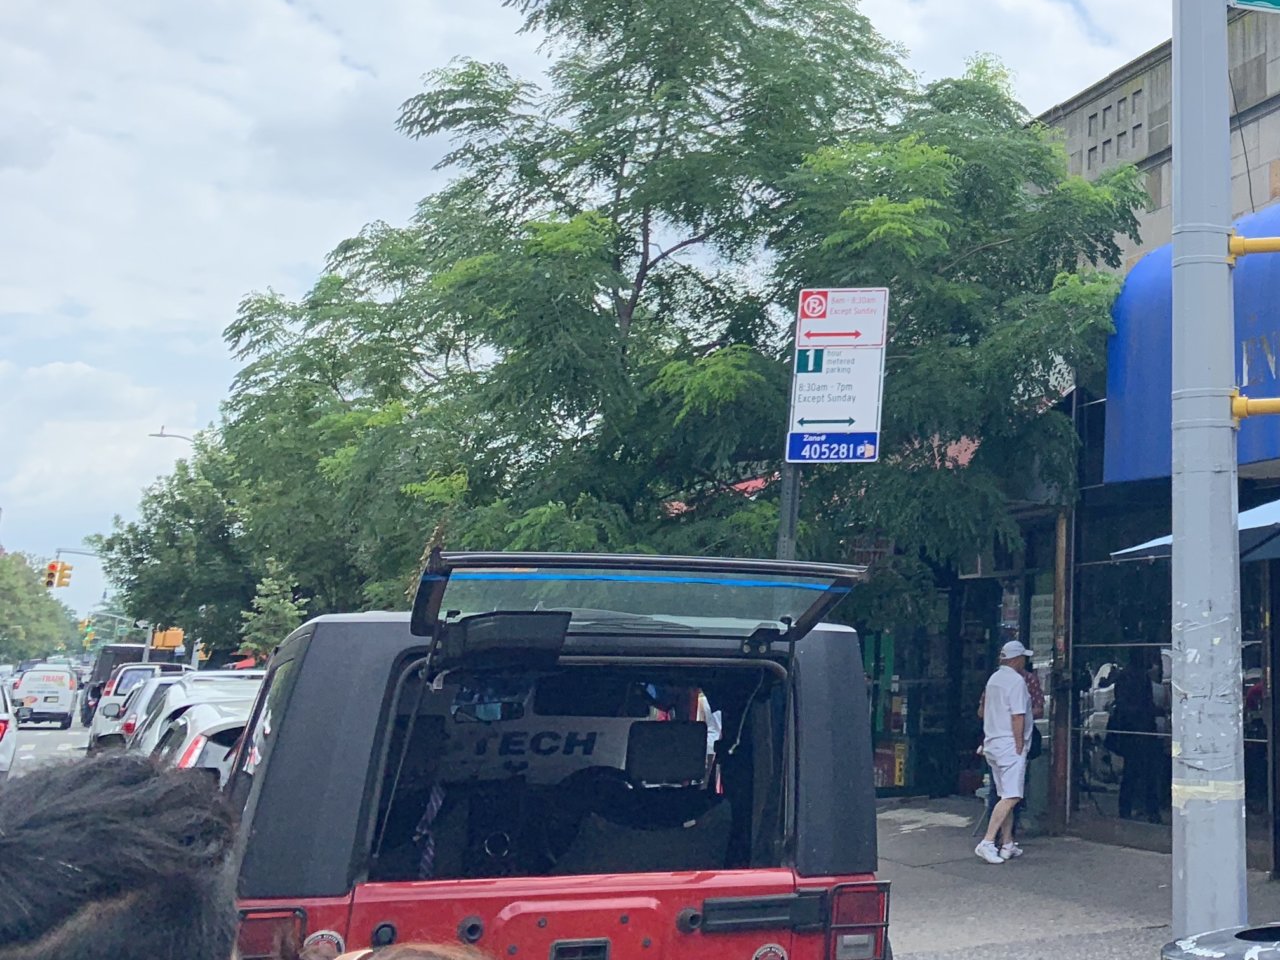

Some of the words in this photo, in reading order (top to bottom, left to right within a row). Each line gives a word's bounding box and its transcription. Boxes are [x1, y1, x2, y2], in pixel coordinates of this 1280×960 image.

[806, 349, 815, 372] 1
[798, 383, 828, 392] 8:30am
[836, 383, 853, 392] 7pm
[798, 394, 825, 404] Except
[827, 394, 857, 404] Sunday
[801, 443, 854, 459] 405281
